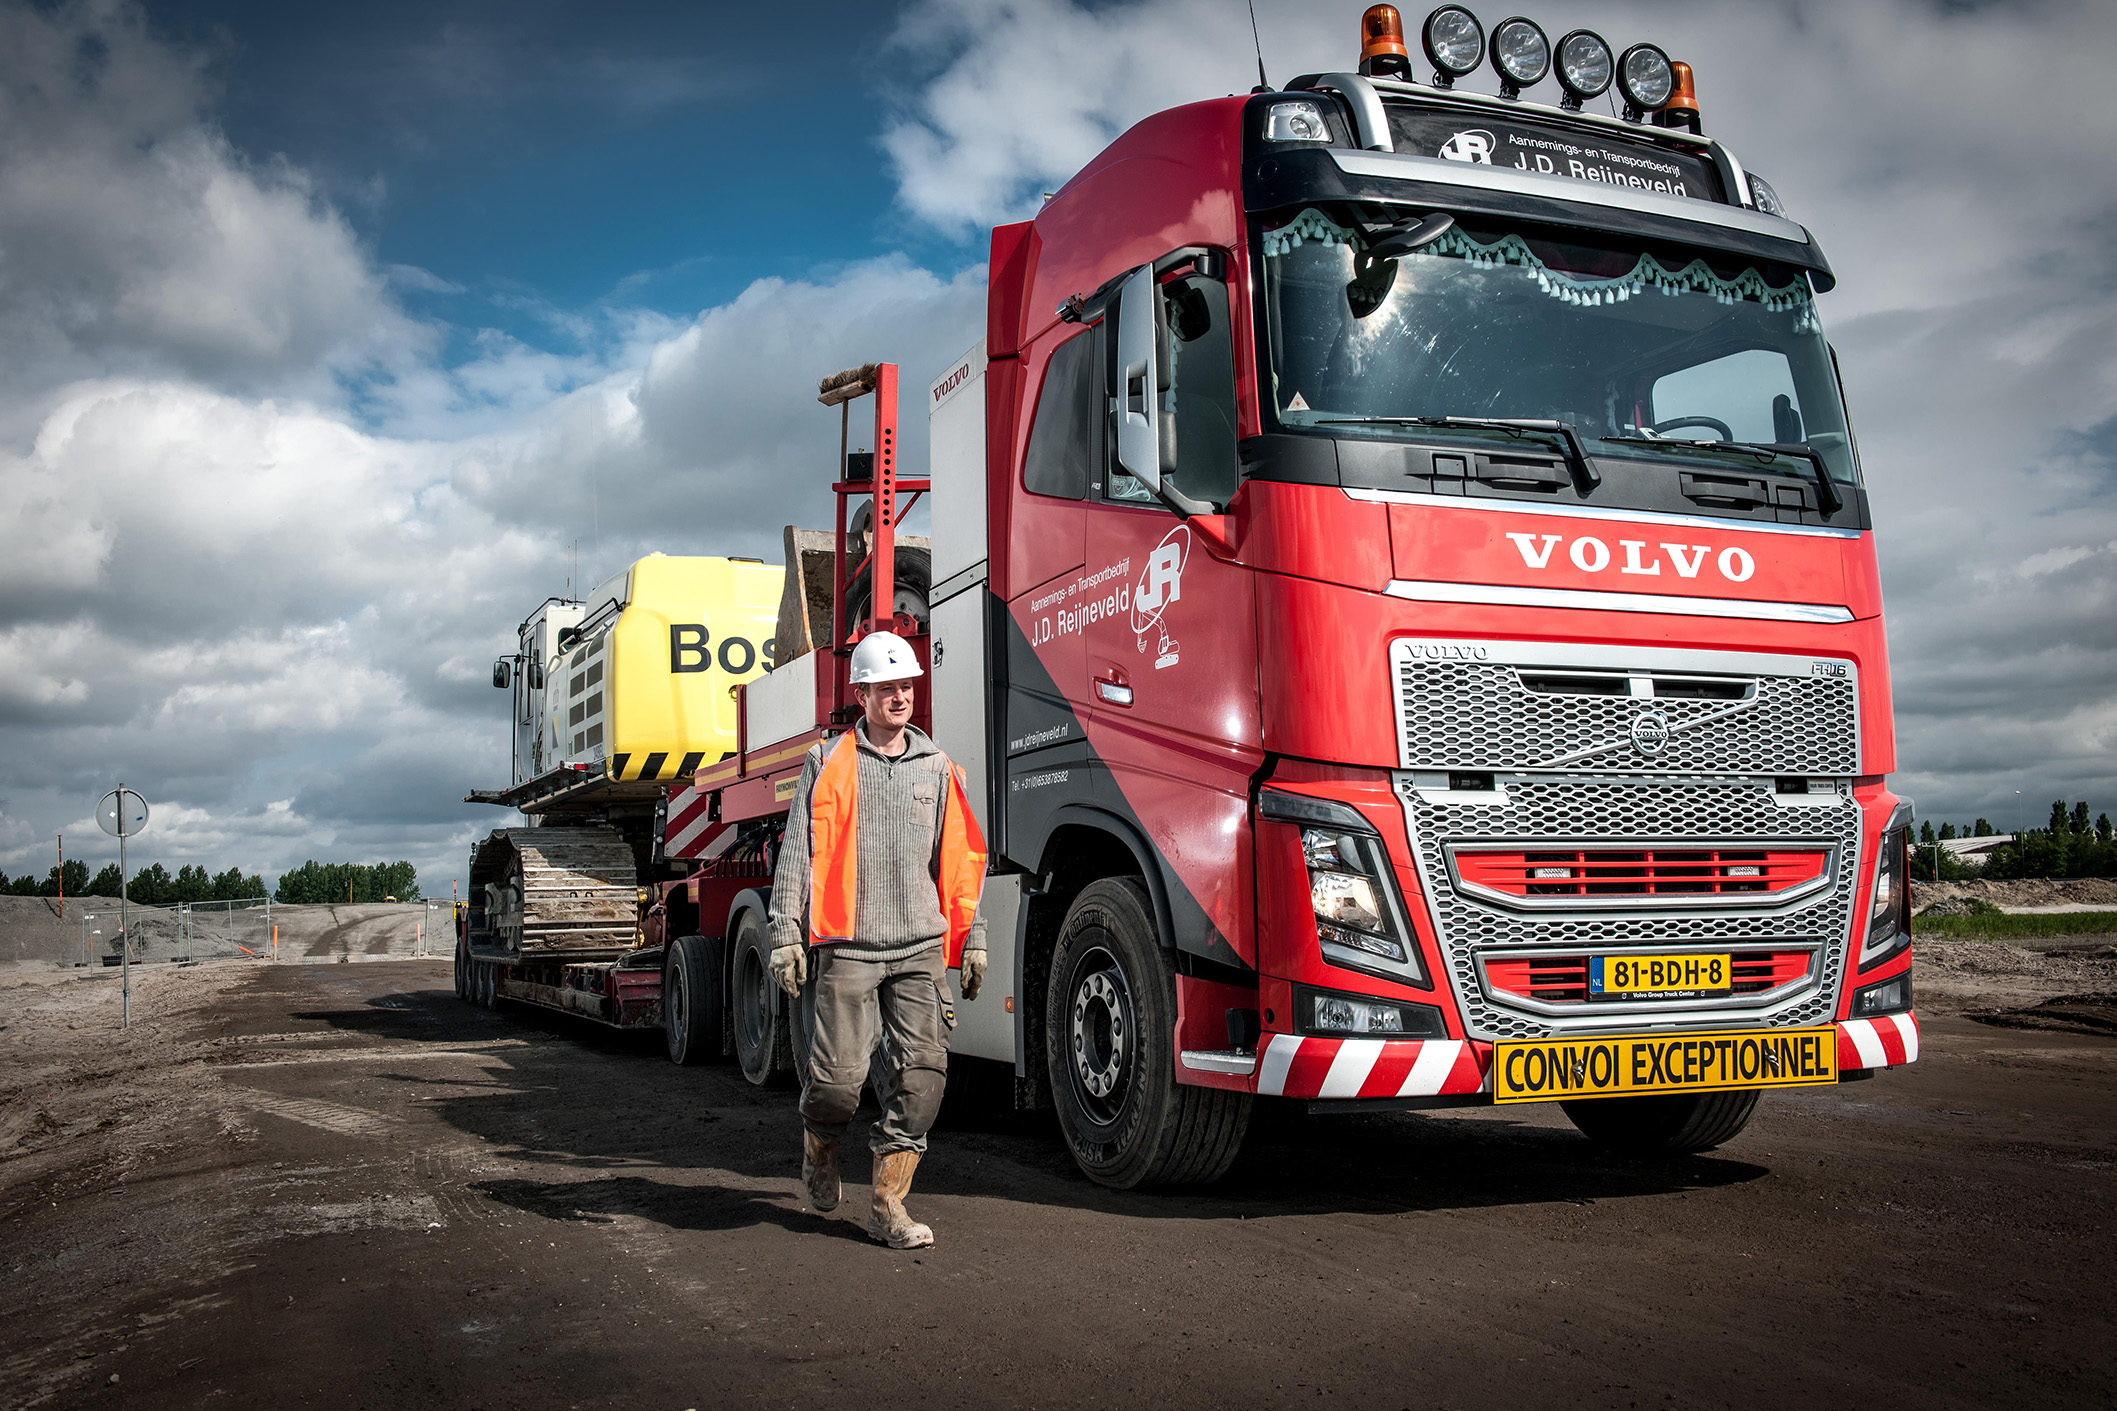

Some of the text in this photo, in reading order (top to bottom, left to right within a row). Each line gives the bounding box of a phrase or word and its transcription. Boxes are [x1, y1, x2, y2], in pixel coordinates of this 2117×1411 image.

[1508, 133, 1681, 178] Aannemings- en Transportbedrijf
[1514, 151, 1563, 176] J.D.
[933, 363, 969, 402] VOLVO
[1505, 532, 1755, 582] VOLVO
[1031, 557, 1130, 613] Aannemings- en Transportbedrijf
[1032, 583, 1130, 647] J.D. Reijneveld
[1404, 644, 1488, 661] VOLVO
[1812, 661, 1848, 677] FH16
[1010, 723, 1069, 750] www.jdreijneveld.nl
[1634, 730, 1667, 738] VOLVO
[1592, 978, 1602, 987] NL
[1614, 958, 1723, 988] 81-BDH-8
[1117, 979, 1150, 1155] CONTINENTAL
[1505, 1036, 1829, 1093] CONVOI EXCEPTIONNEL
[1074, 1134, 1104, 1164] HSR2
